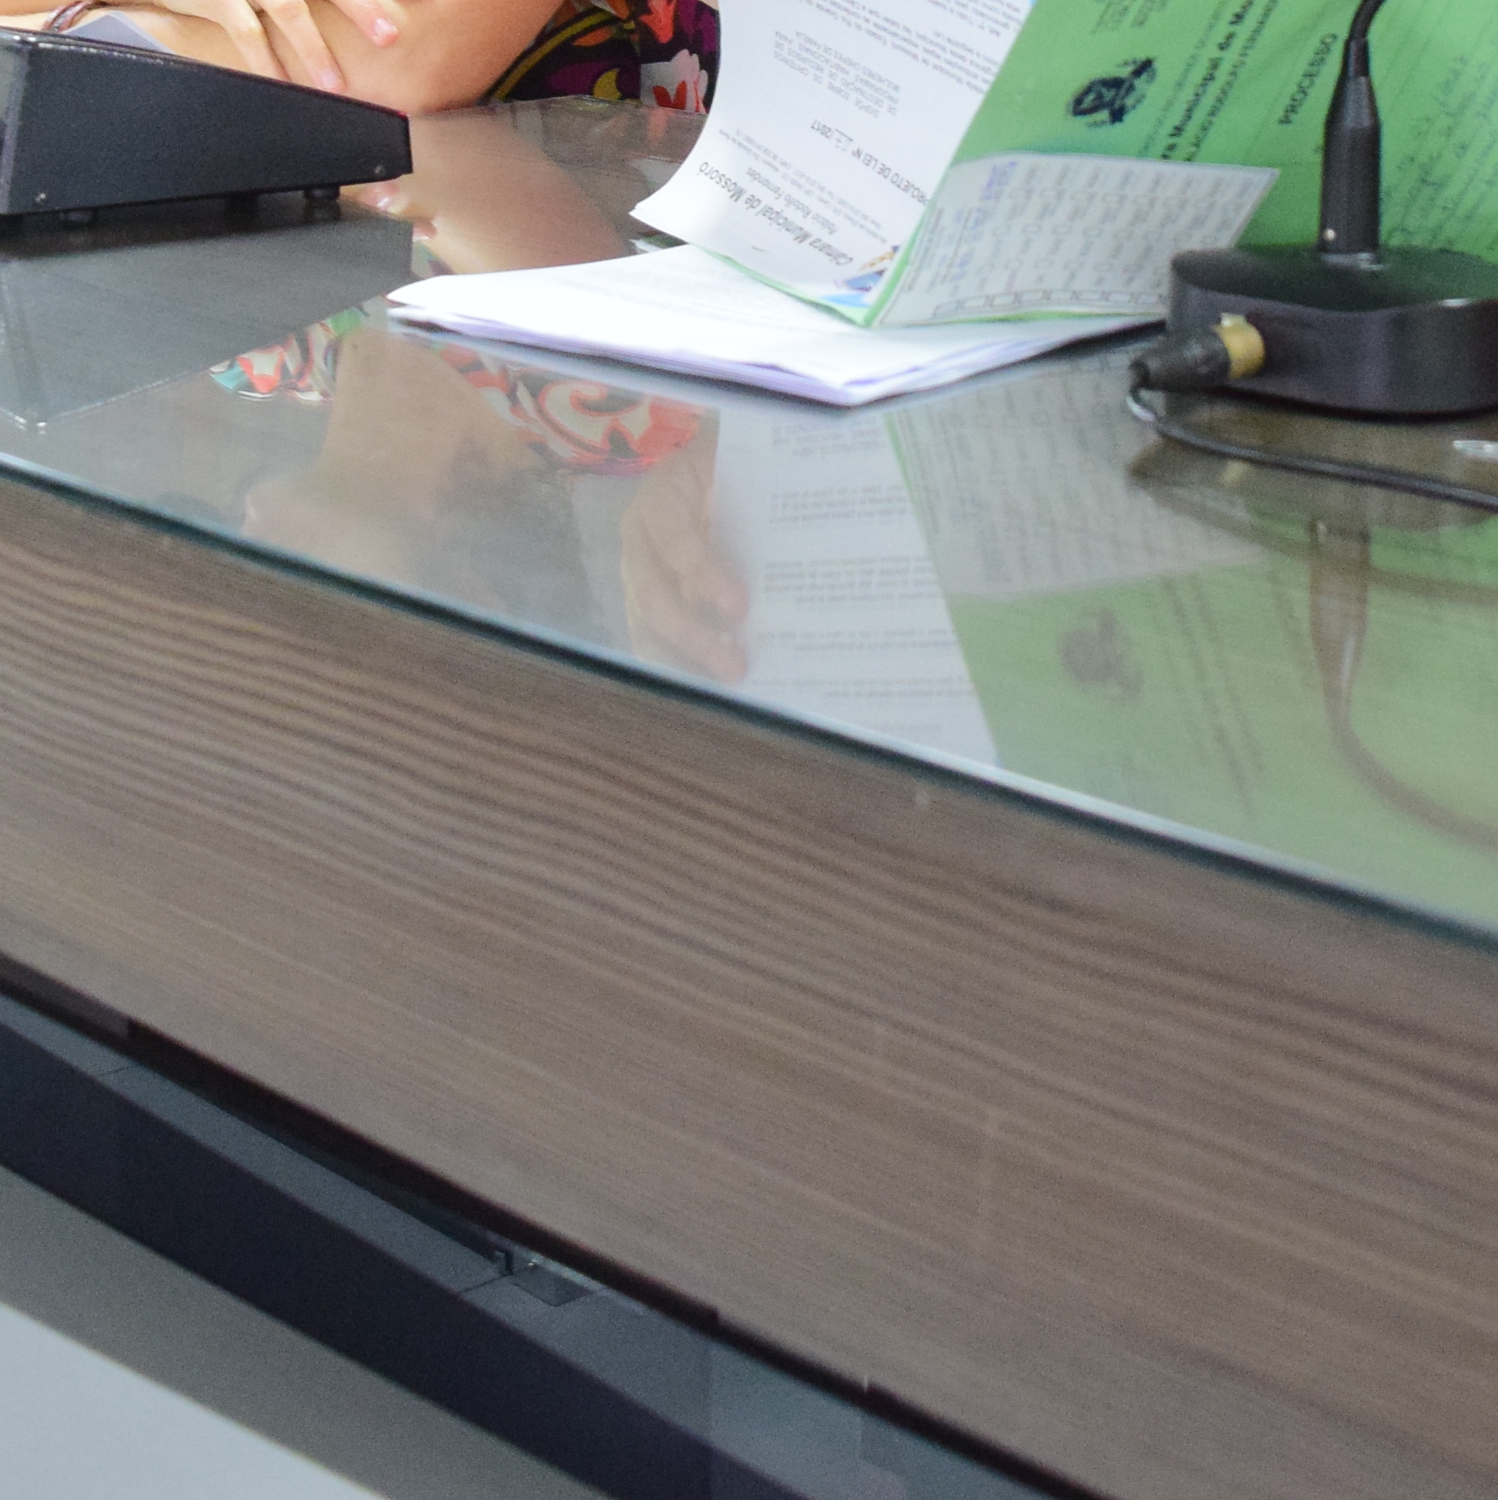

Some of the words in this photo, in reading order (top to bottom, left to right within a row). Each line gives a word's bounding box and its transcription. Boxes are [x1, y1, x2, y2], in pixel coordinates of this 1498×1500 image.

[698, 161, 743, 202] Mossoró
[876, 163, 891, 178] DE
[742, 193, 761, 213] de
[755, 199, 813, 247] Municipal
